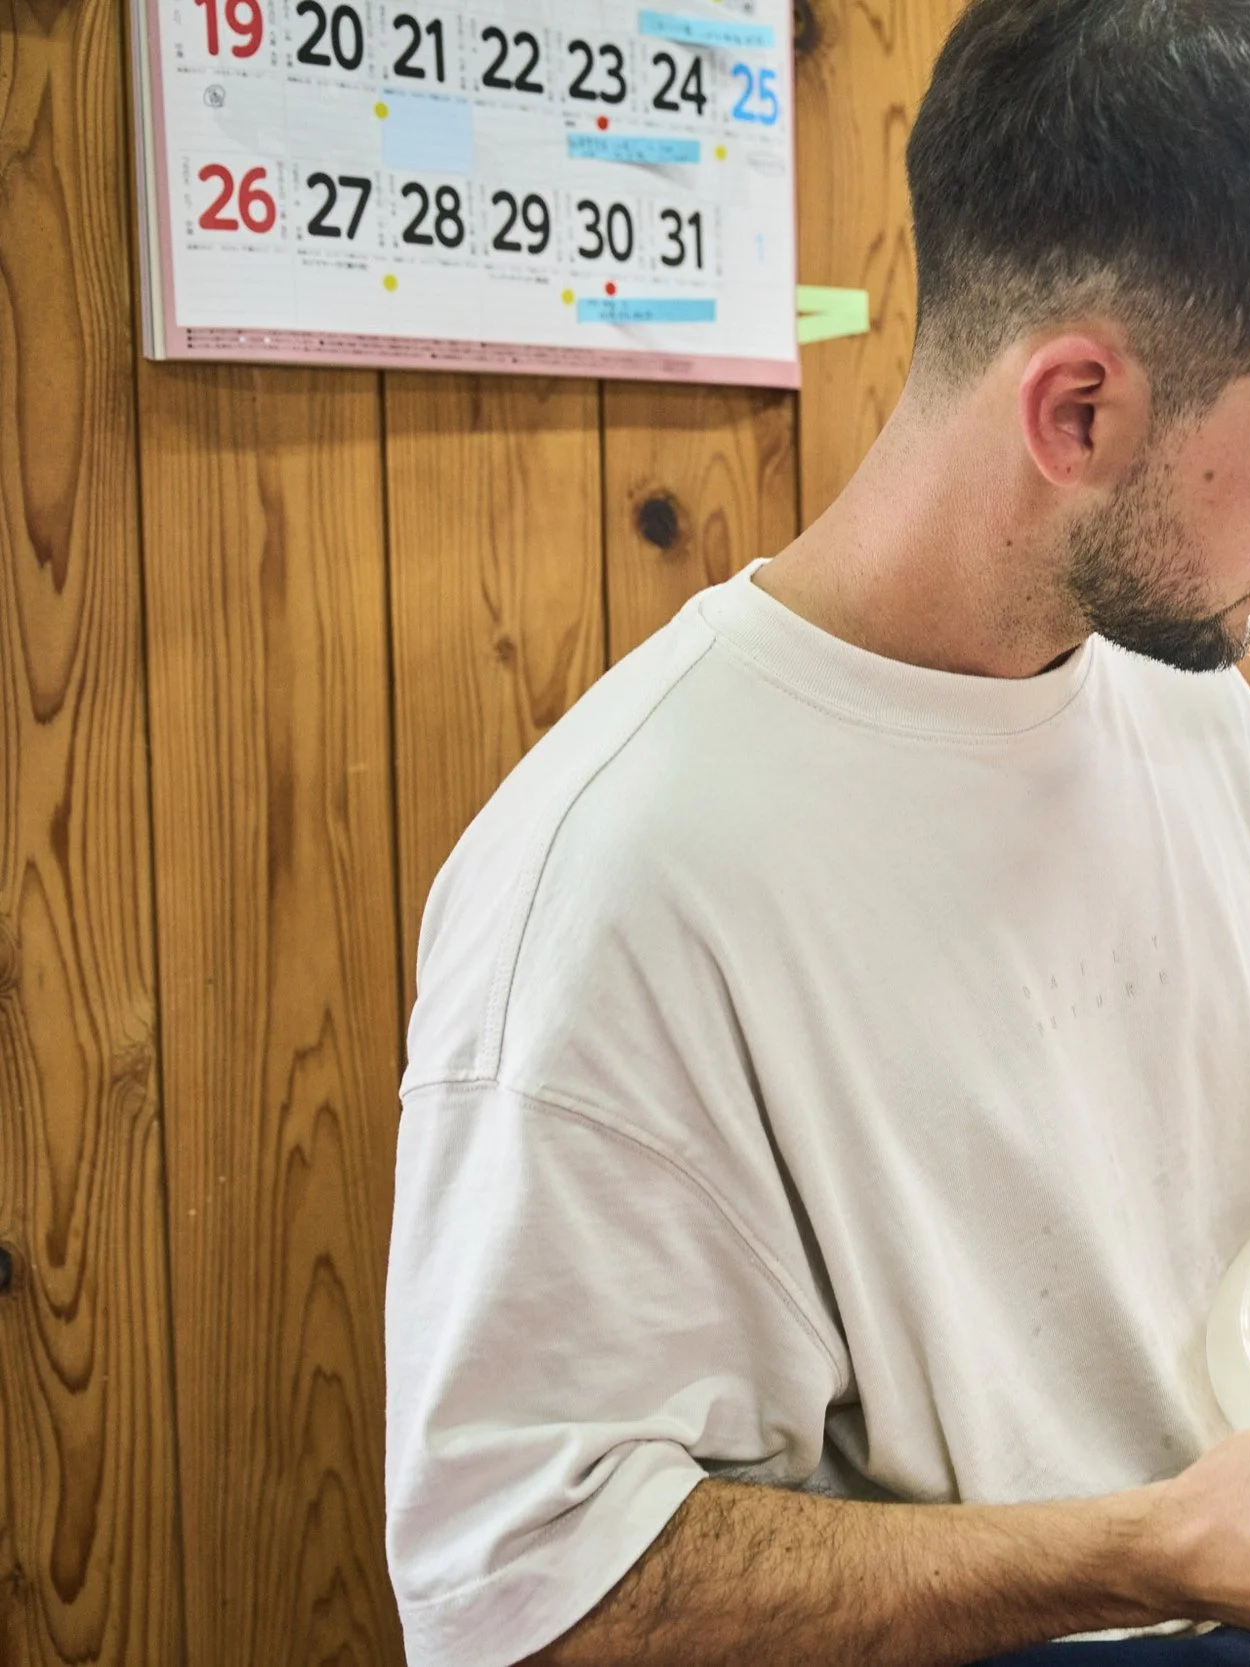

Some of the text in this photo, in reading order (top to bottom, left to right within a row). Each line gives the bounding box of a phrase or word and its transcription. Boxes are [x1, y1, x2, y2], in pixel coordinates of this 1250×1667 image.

[194, 0, 264, 59] 19
[295, 0, 364, 71] 20
[392, 13, 446, 83] 21
[481, 26, 544, 94] 22
[567, 39, 628, 105] 23
[651, 52, 707, 116] 24
[730, 63, 779, 126] 25
[197, 163, 277, 234] 26
[306, 172, 372, 240] 27
[401, 181, 465, 249] 28
[491, 190, 551, 255] 29
[576, 199, 634, 262] 30
[660, 208, 703, 269] 31
